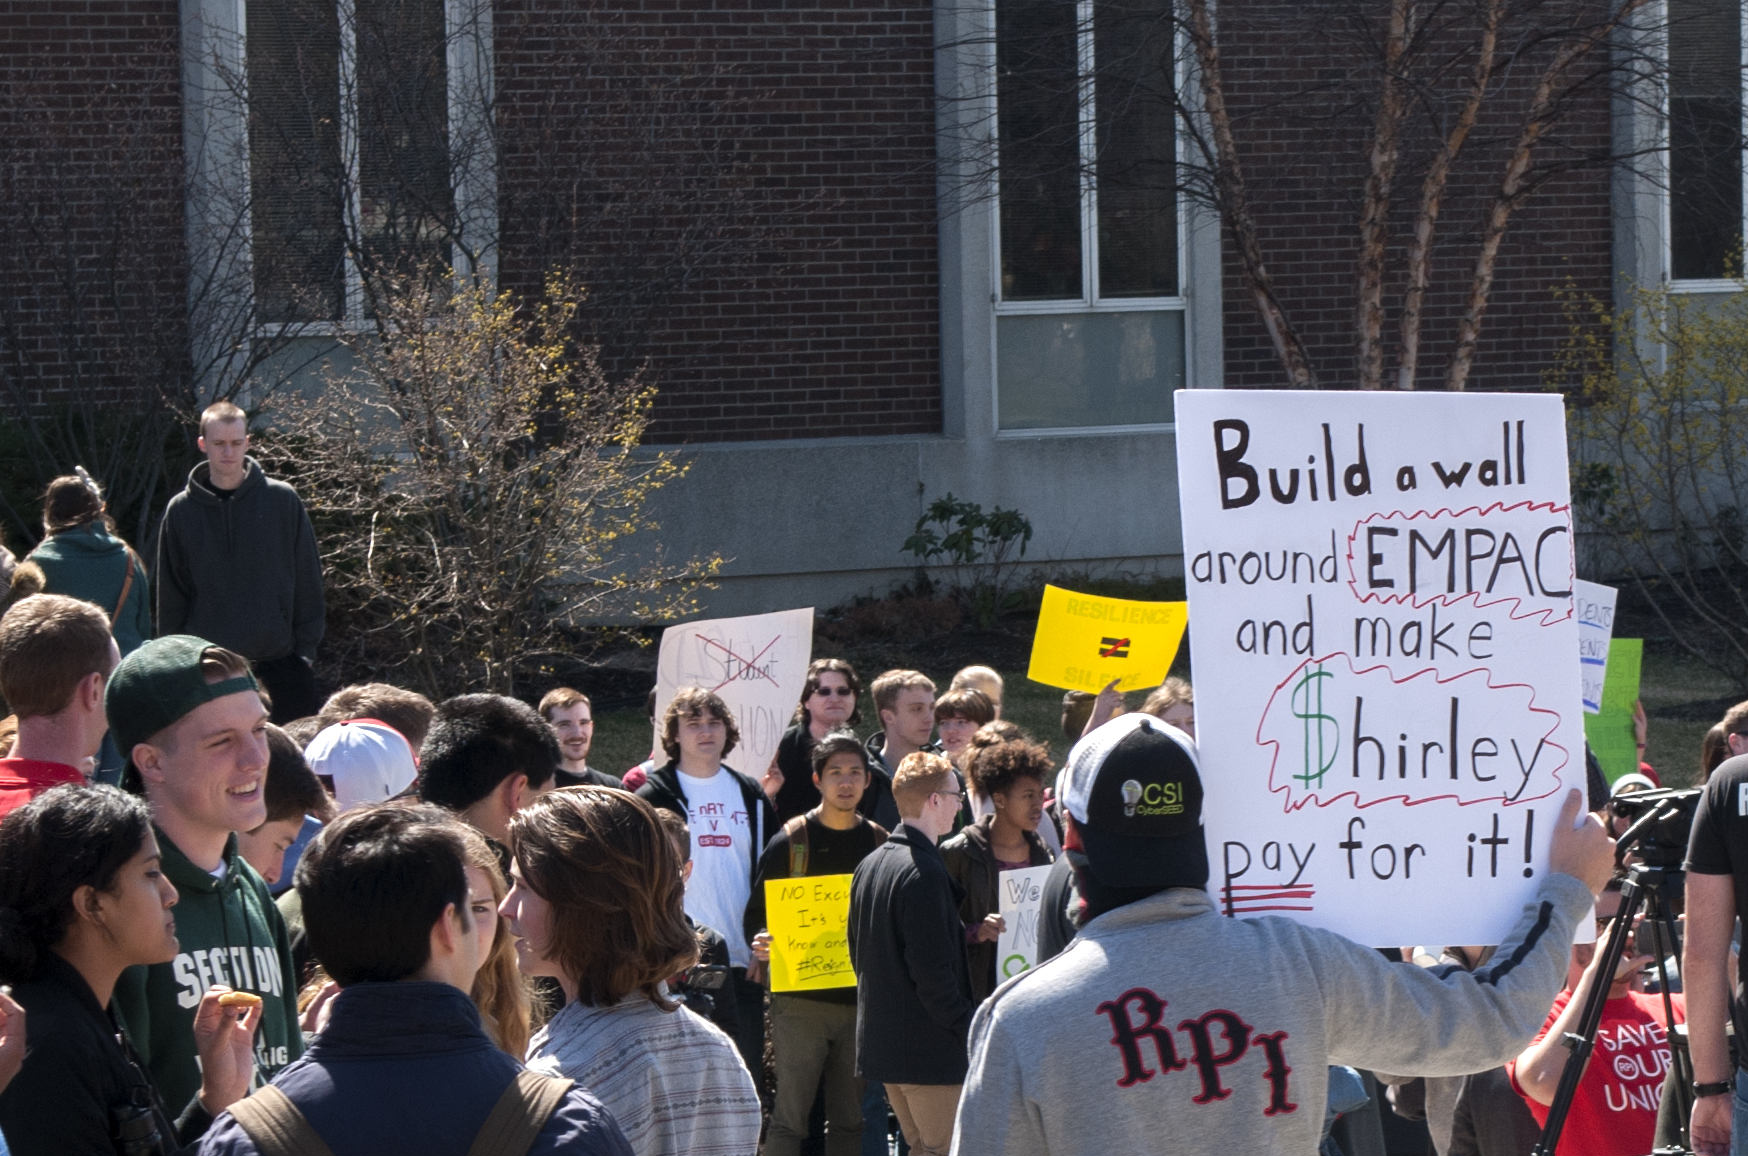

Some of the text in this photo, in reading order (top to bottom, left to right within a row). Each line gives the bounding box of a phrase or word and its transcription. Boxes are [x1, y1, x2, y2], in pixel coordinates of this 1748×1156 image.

[1213, 418, 1526, 510] Build a wall
[1191, 525, 1573, 598] around EMPAC
[1066, 598, 1173, 625] RESILIENCE
[1236, 594, 1494, 660] and make
[1576, 597, 1613, 627] DENTS
[1291, 663, 1546, 802] $hirley
[1143, 782, 1183, 805] CSI
[1223, 809, 1535, 918] pay for it!
[781, 884, 851, 902] NO Excu
[172, 945, 284, 1009] SECTION
[1096, 987, 1298, 1117] RPI
[1597, 1021, 1668, 1051] SAVE
[1614, 1048, 1673, 1080] OUR
[1604, 1083, 1664, 1112] UNI
